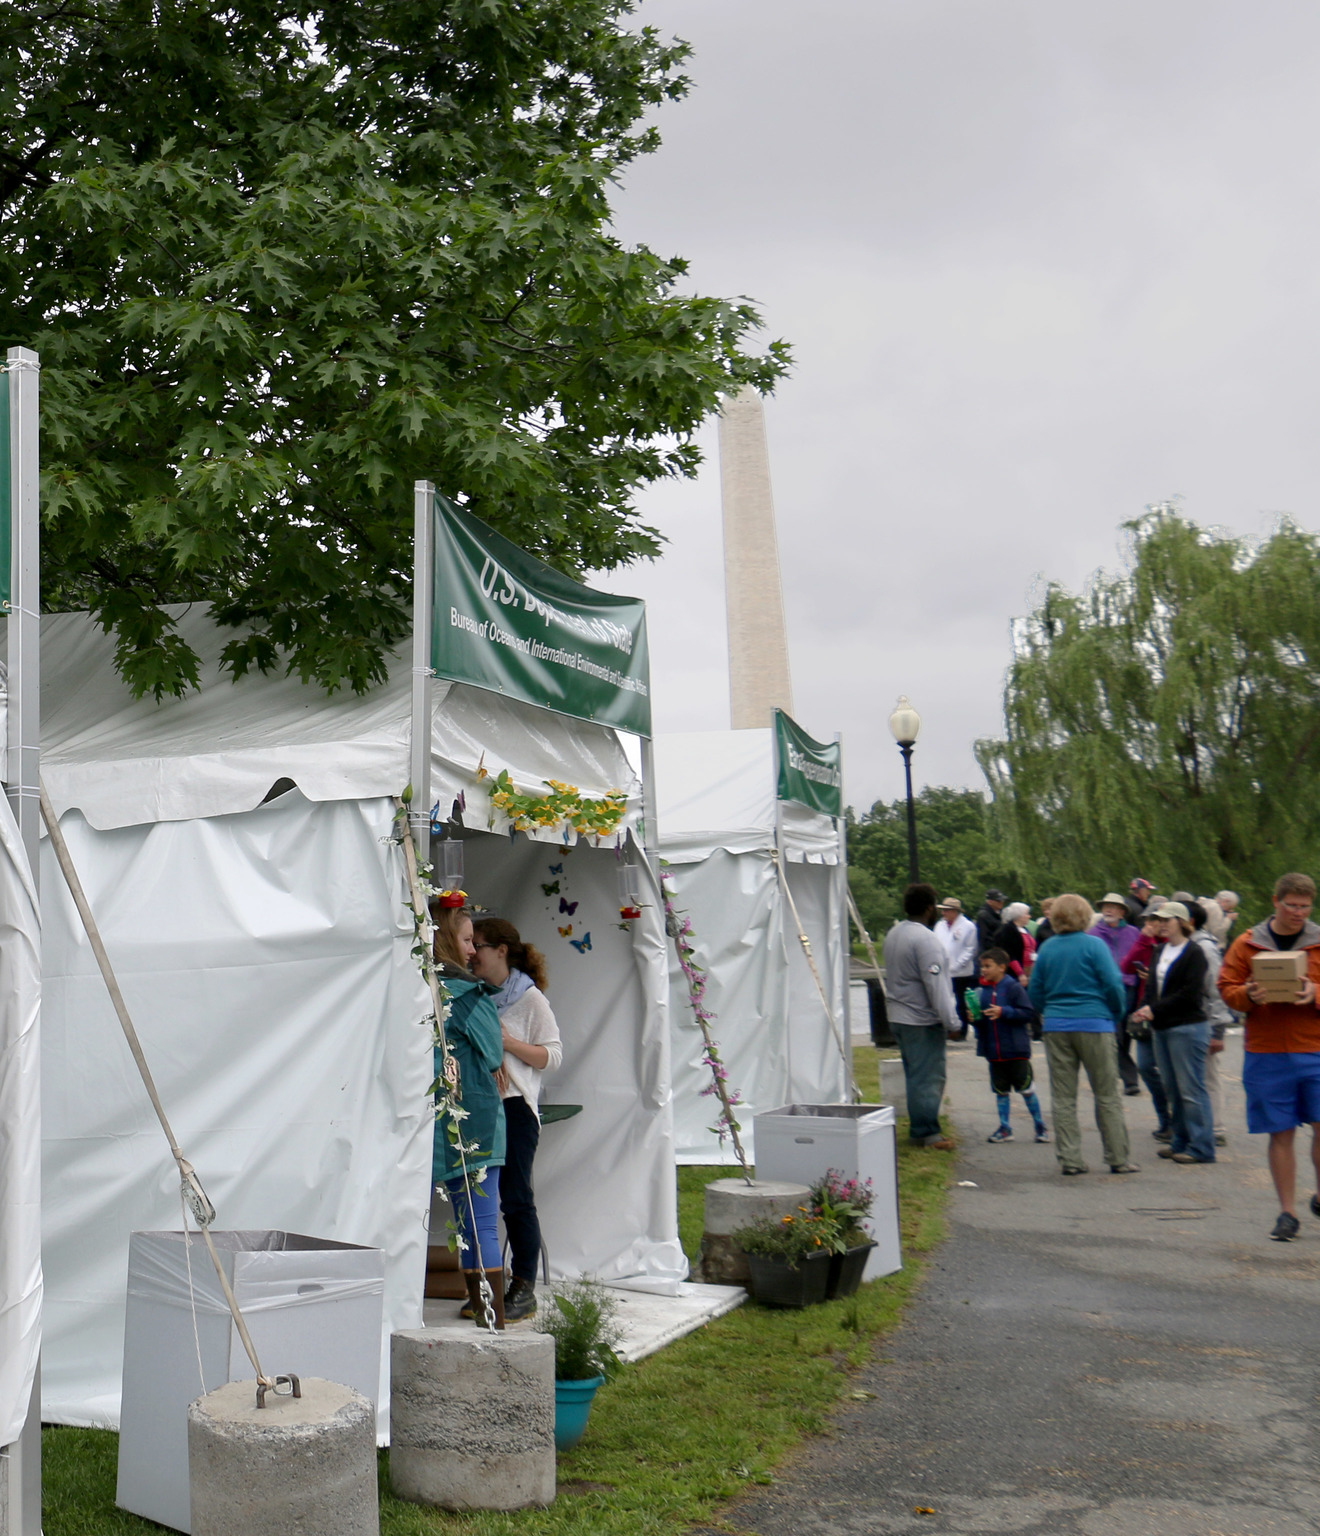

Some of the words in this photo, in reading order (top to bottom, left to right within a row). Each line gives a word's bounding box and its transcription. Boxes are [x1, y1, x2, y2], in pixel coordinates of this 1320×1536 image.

[450, 606, 478, 637] Bureau
[478, 620, 489, 639] of
[489, 621, 517, 649] Oceans
[515, 637, 532, 655] and
[531, 638, 577, 669] International
[479, 557, 518, 607] U.S.
[600, 618, 633, 656] State
